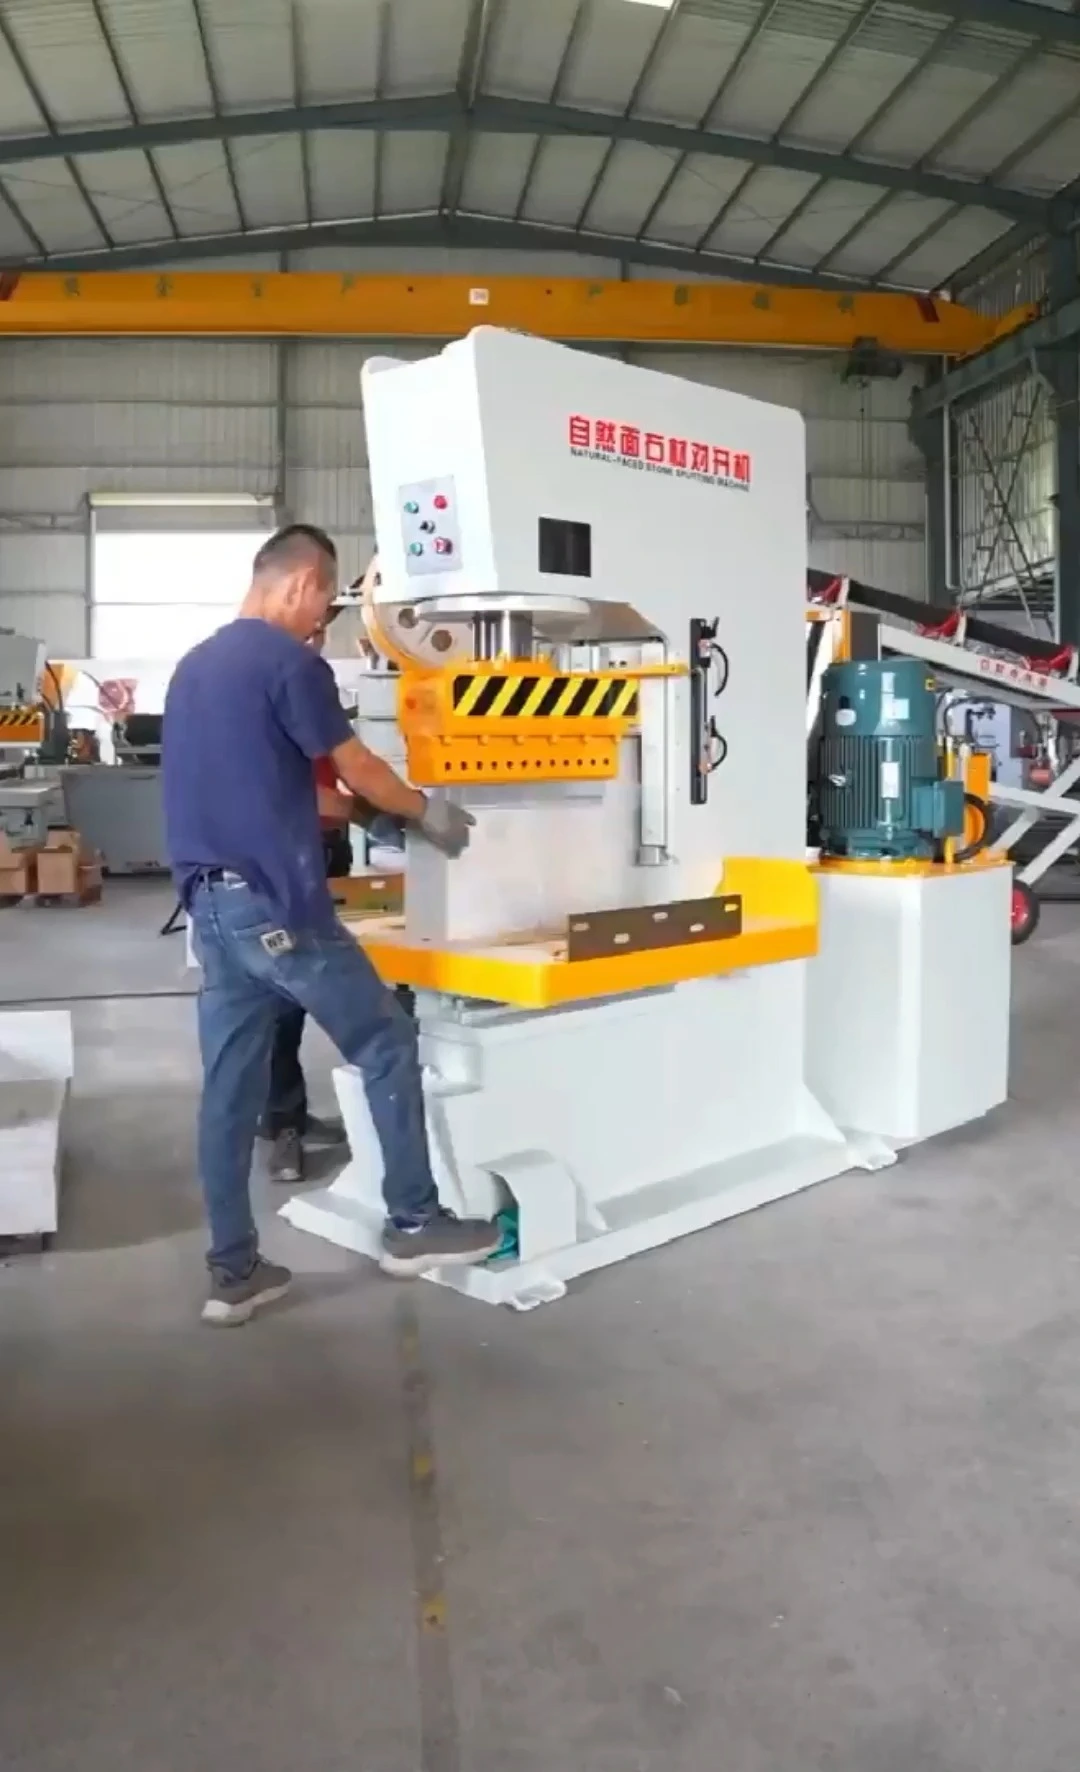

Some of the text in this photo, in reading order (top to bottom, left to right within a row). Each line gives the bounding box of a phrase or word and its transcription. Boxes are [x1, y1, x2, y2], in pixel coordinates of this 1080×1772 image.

[569, 415, 751, 483] 自然面石材对开机
[570, 446, 644, 470] NATURAL-FACED
[645, 462, 673, 476] STONE
